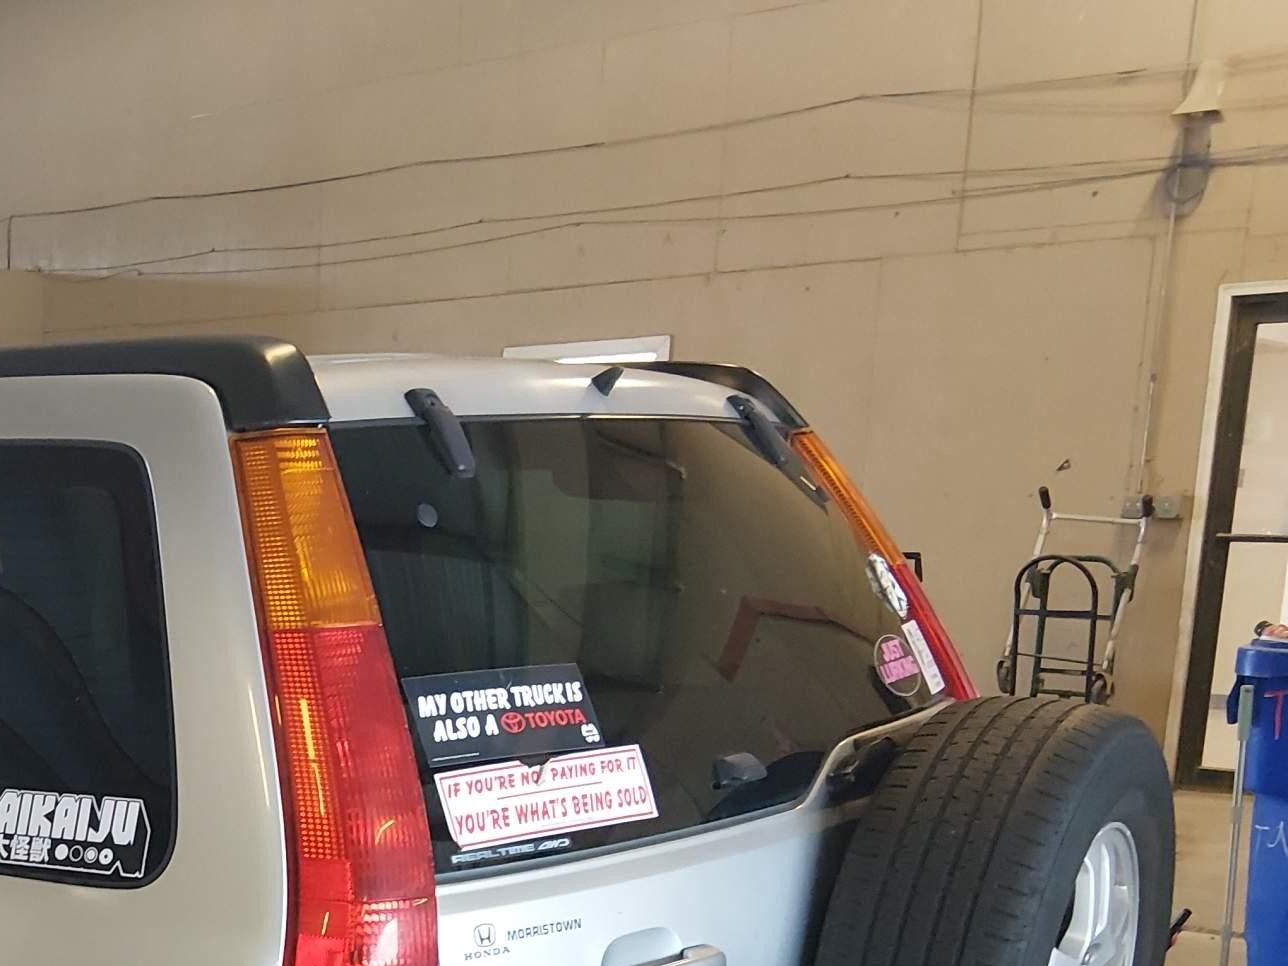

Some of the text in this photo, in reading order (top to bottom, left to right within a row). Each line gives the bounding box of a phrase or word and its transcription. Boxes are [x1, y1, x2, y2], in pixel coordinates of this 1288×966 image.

[417, 681, 583, 718] MY OTHER TRUCK IS
[433, 708, 587, 743] ALSO A TOYOTA
[447, 756, 638, 798] IF YOU'RE NO PAYING FOR IT
[455, 784, 648, 835] YOU'RE WHAT'S BEING SOLD
[506, 917, 583, 942] MORRISTOWN
[463, 945, 511, 961] HONDA
